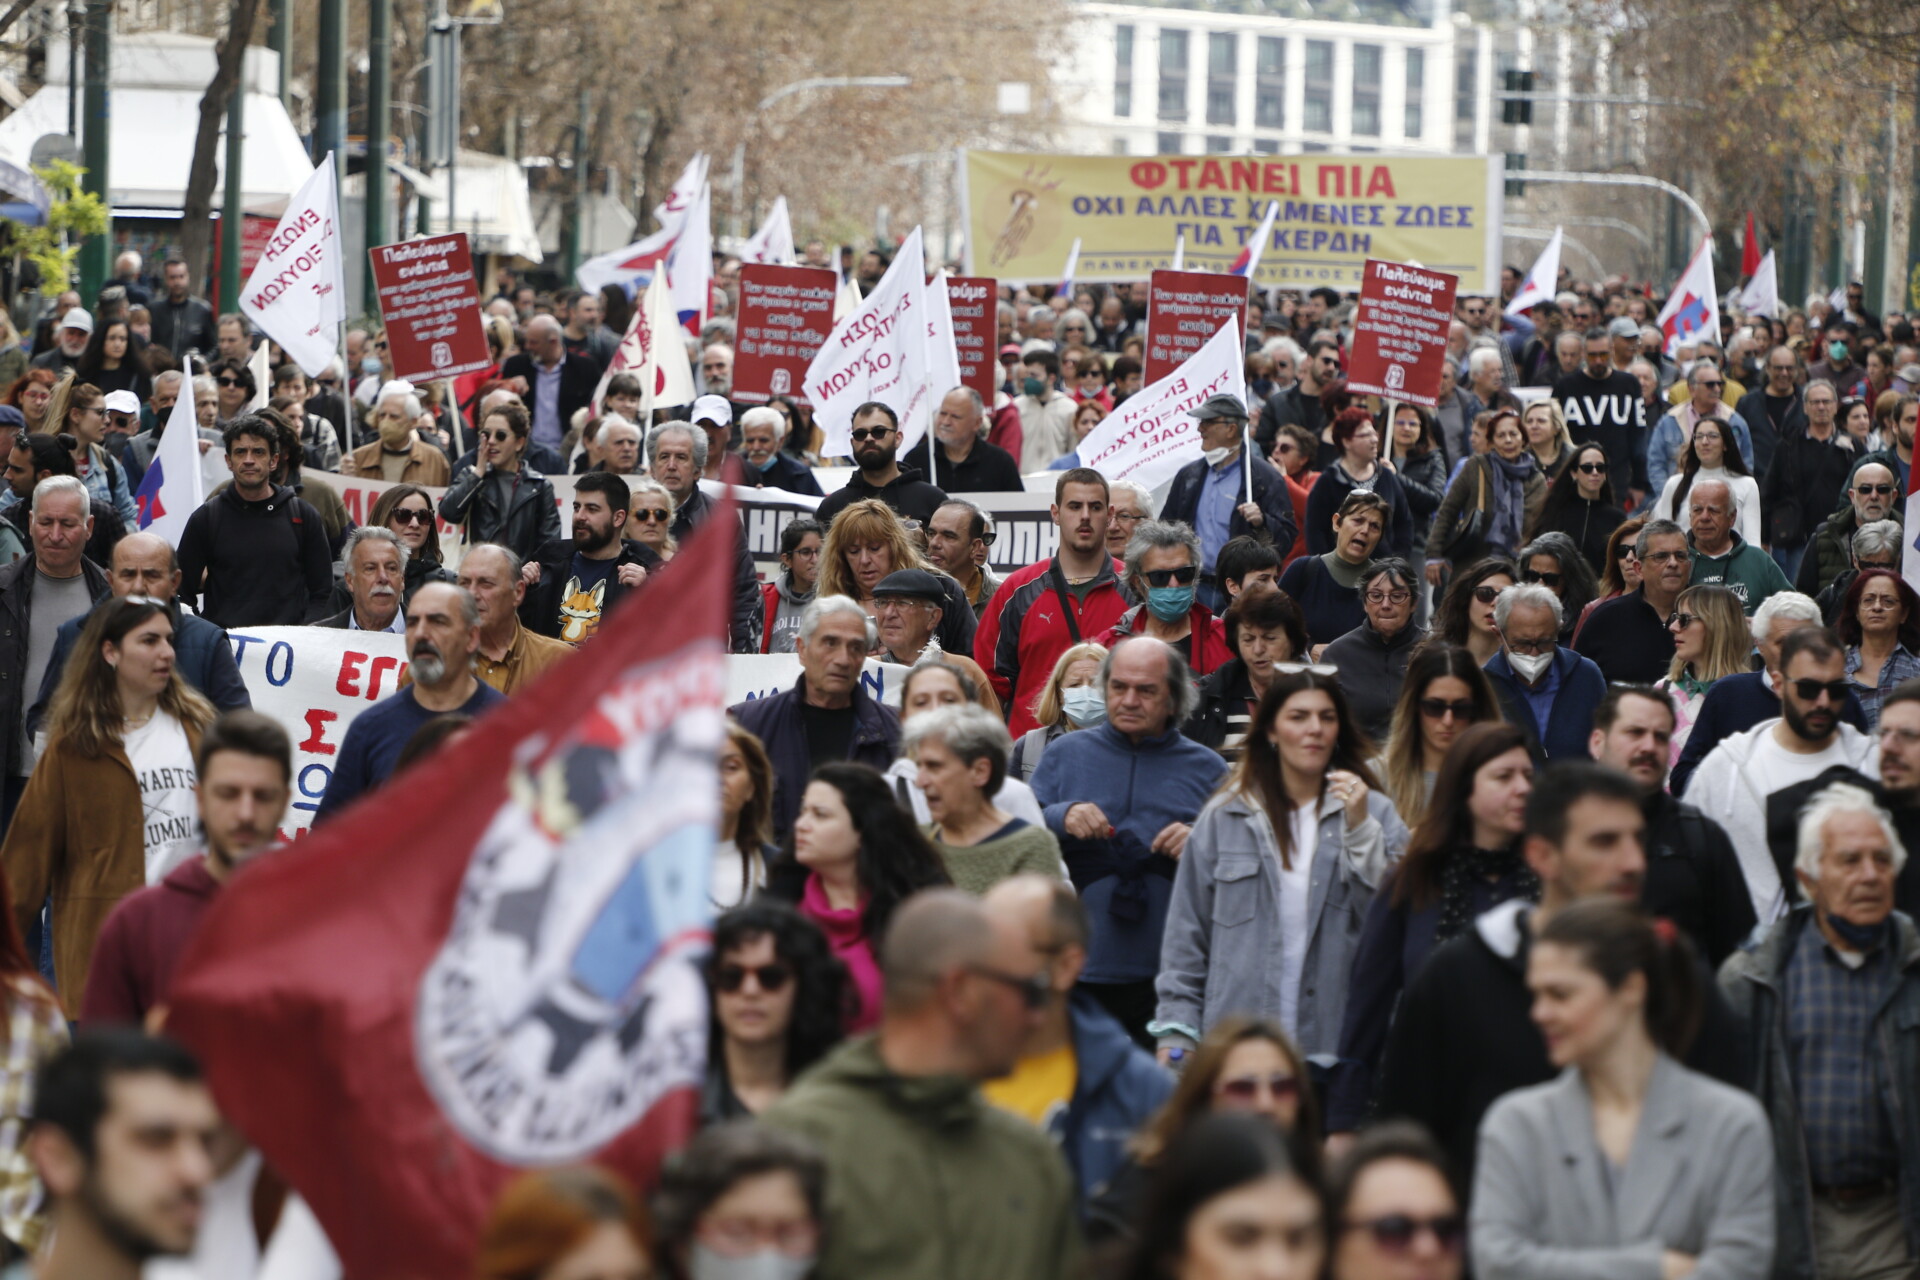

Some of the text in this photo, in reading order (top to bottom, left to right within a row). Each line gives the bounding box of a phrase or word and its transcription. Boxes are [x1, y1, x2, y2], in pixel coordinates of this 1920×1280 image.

[1129, 159, 1396, 199] ΦΤΑΝΕΙ ΠΙΑ
[1072, 195, 1125, 216] ΟΧΙ
[1136, 196, 1237, 220] ΑΛΛΕΣ
[1394, 204, 1474, 229] ΖΩΕΣ
[1273, 229, 1372, 254] ΚΕΡΔΗ
